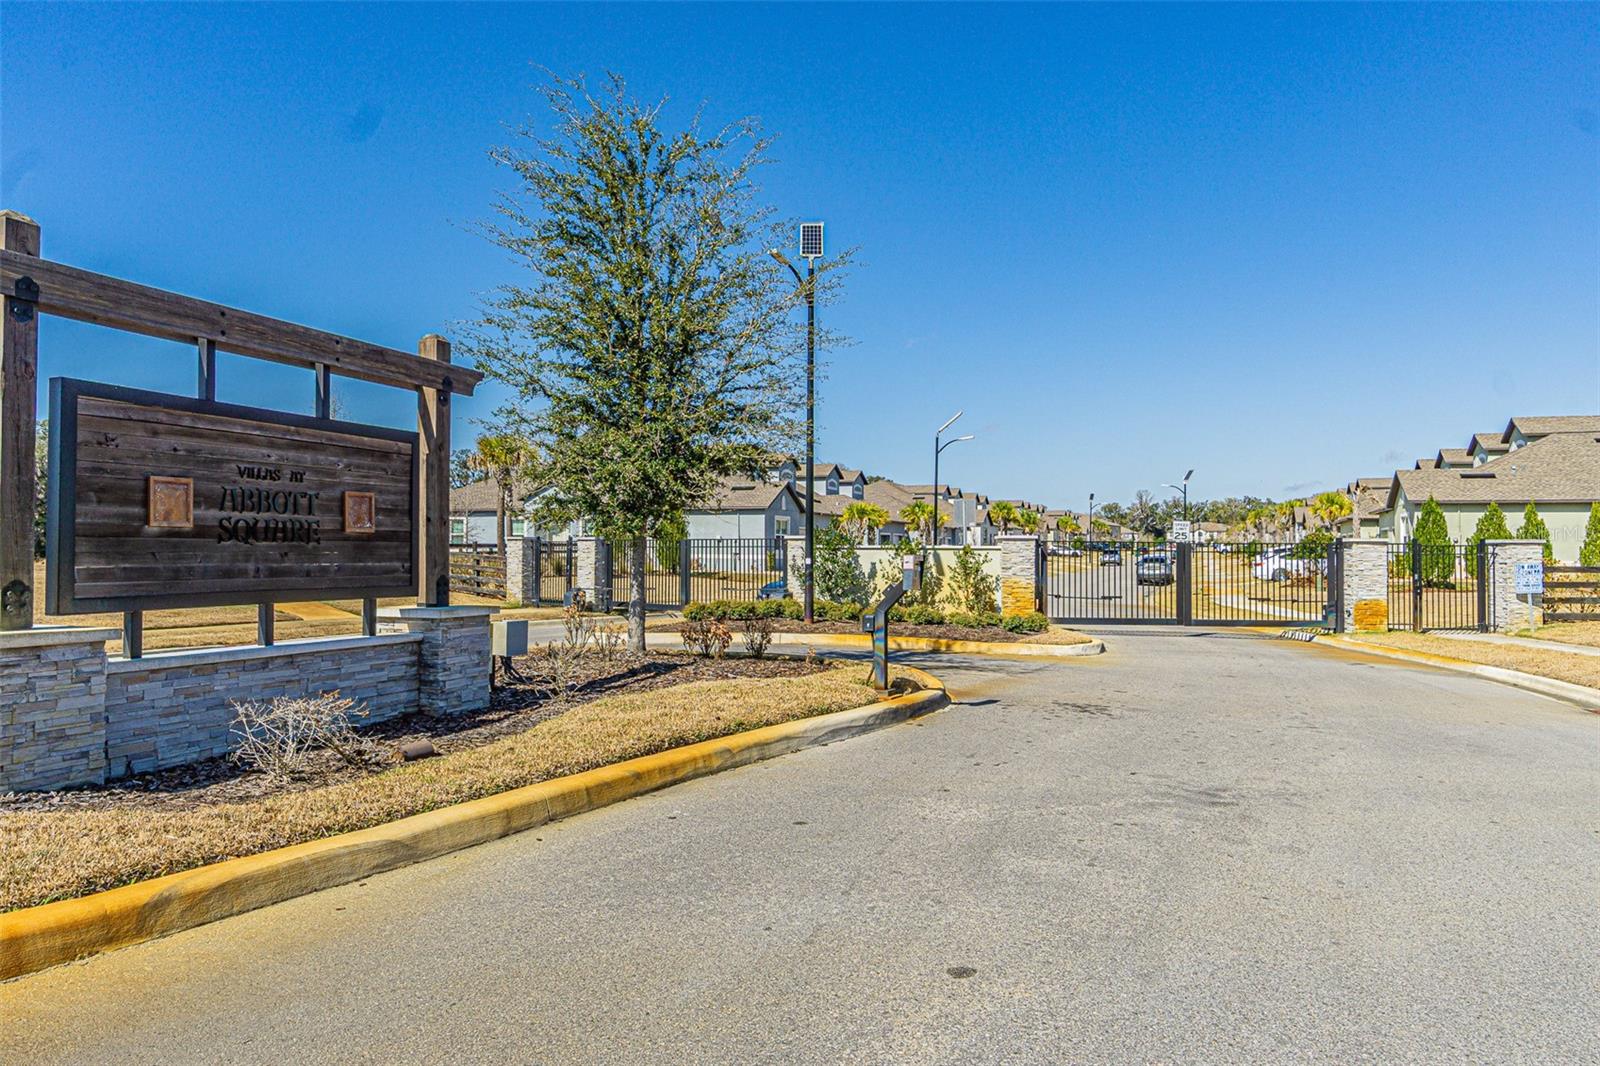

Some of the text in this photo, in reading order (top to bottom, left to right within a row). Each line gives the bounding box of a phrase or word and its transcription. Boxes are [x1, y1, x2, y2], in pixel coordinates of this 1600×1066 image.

[236, 465, 306, 483] VILLAS AT
[219, 486, 320, 516] ABBOTT
[217, 516, 321, 545] SQUARE
[1174, 532, 1188, 540] 25
